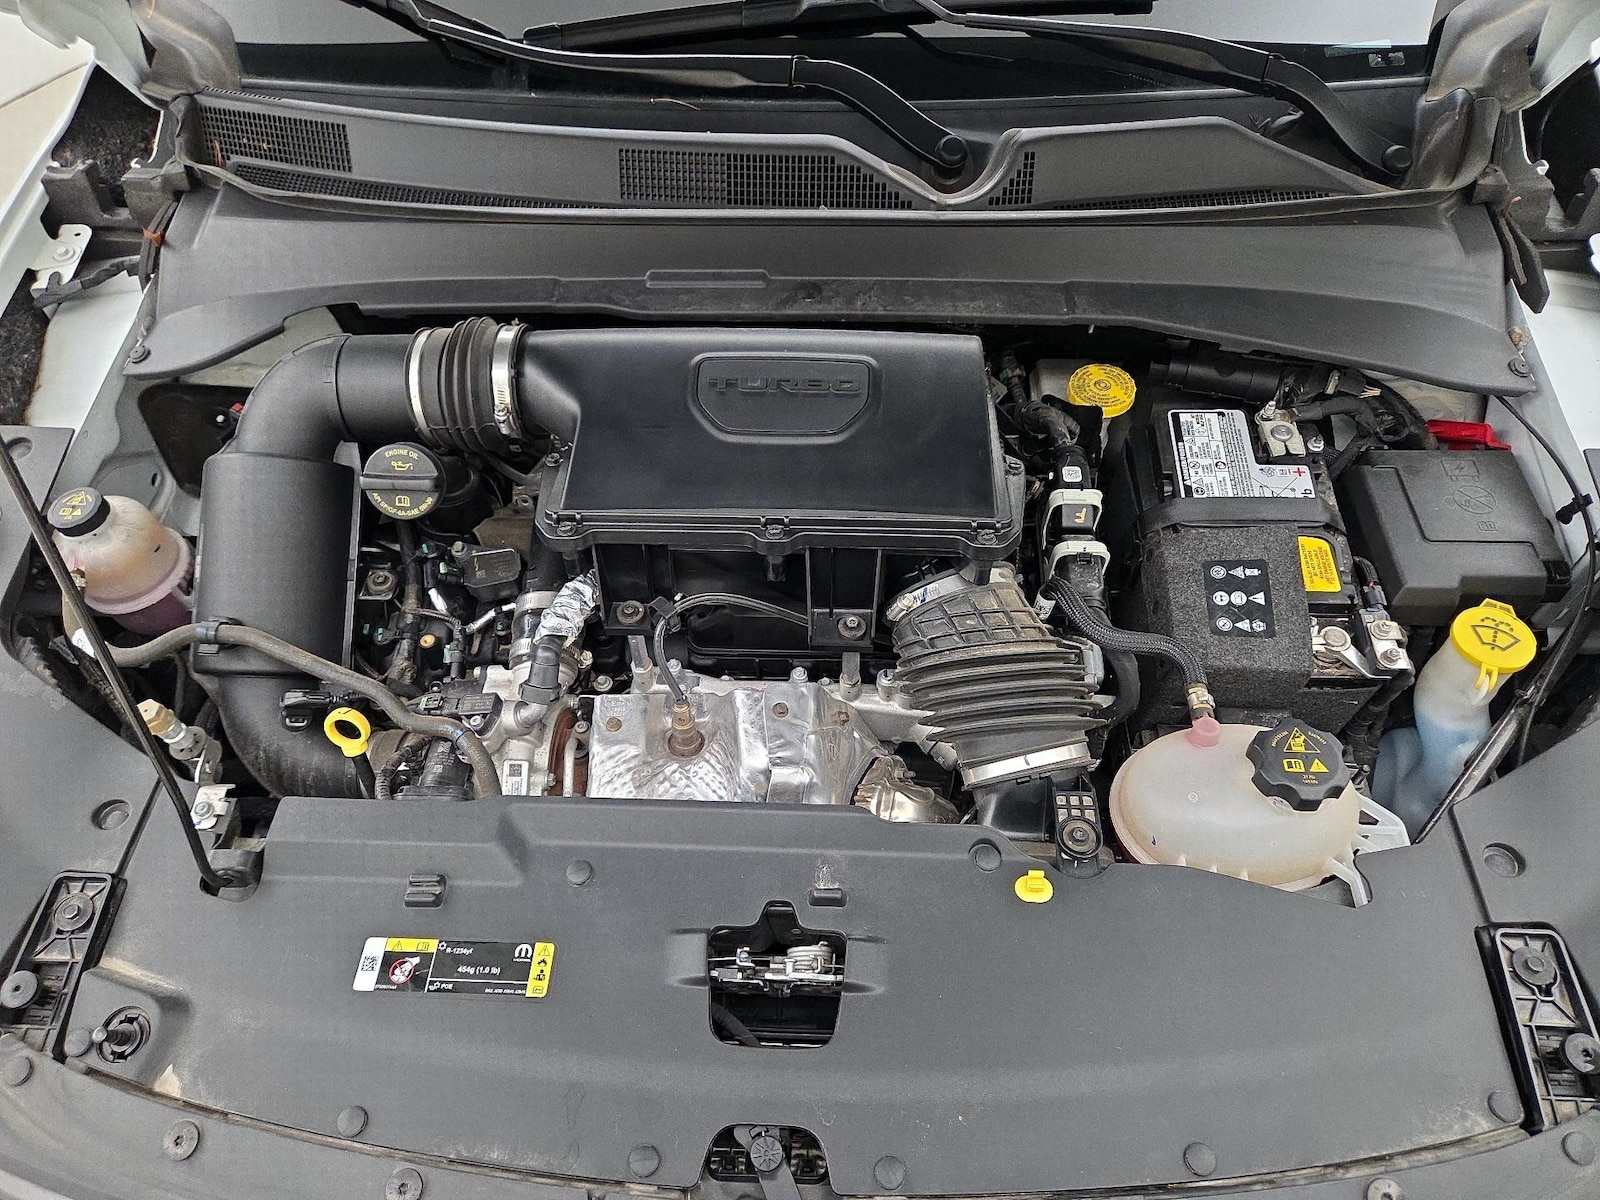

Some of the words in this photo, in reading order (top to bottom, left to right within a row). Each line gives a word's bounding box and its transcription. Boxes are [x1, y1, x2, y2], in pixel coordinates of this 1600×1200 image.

[706, 376, 863, 395] TURBO
[384, 448, 409, 458] ENGINE
[408, 450, 419, 460] OIL
[372, 492, 382, 503] API
[445, 947, 474, 955] R-1234yf
[457, 965, 475, 975] 454g
[475, 965, 490, 975] (1.0
[490, 966, 501, 976] lb)
